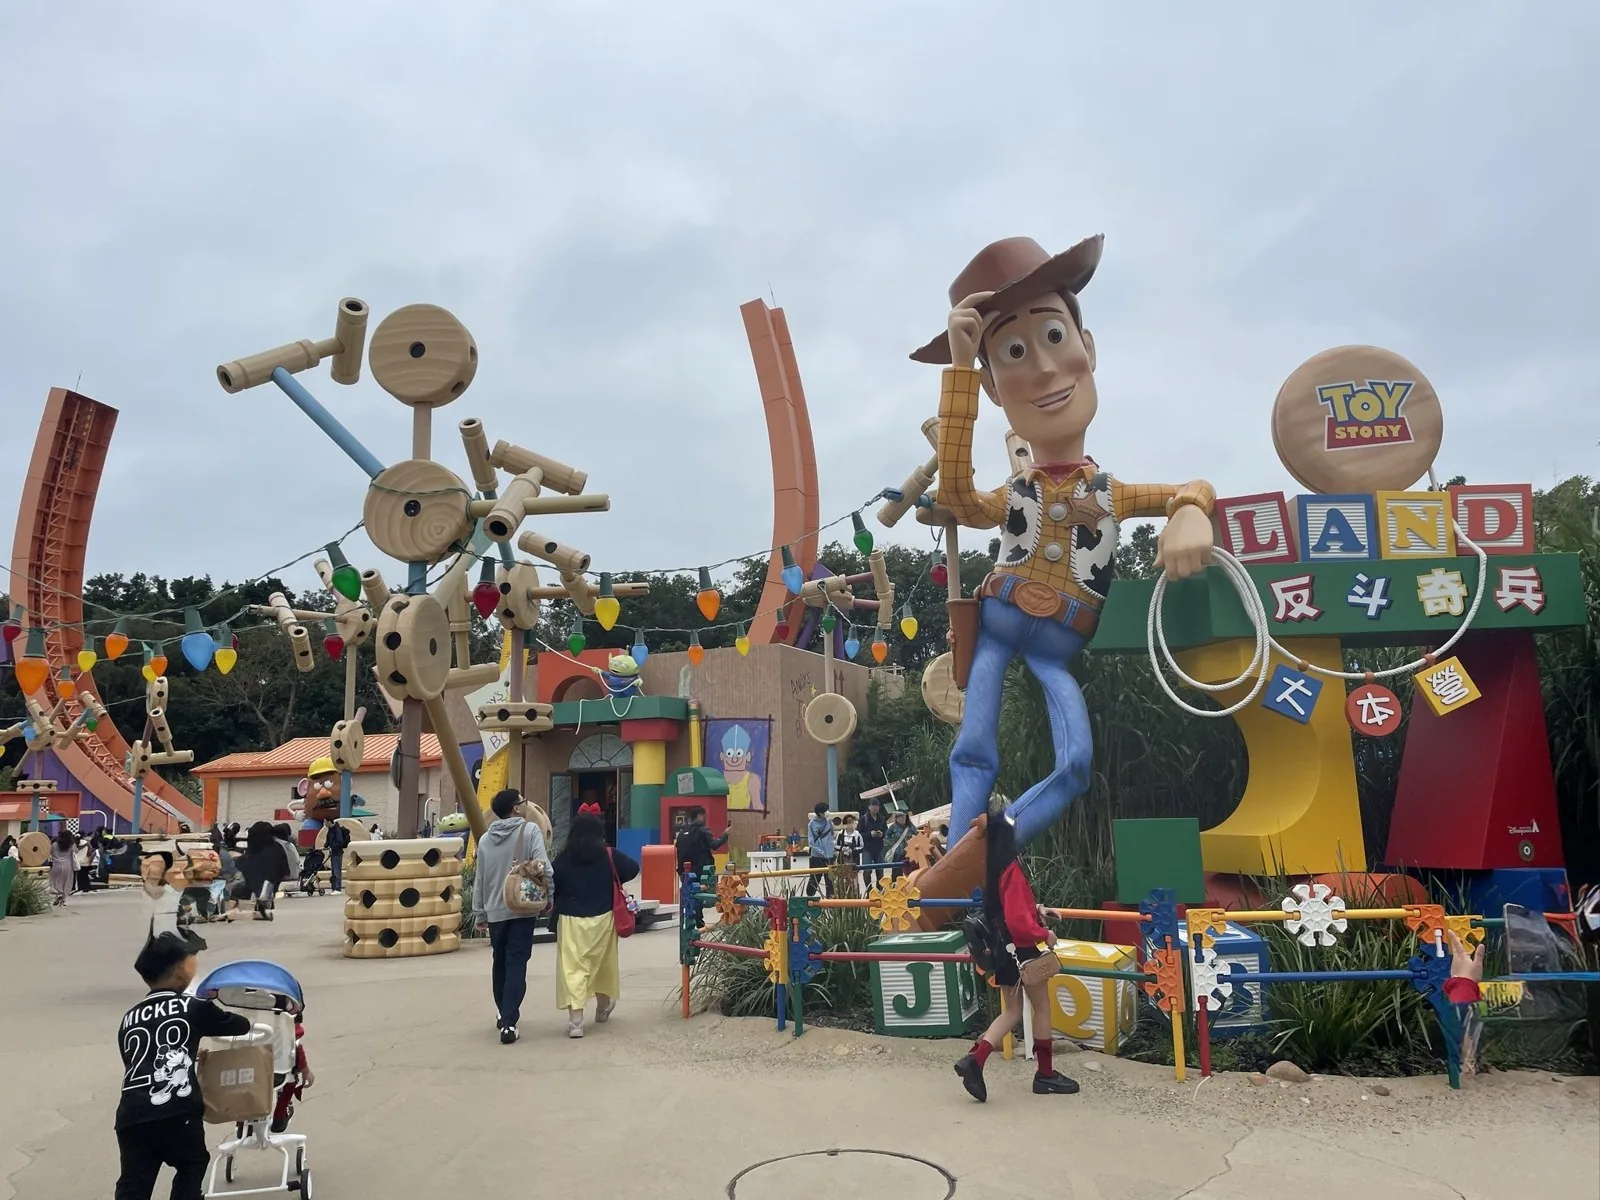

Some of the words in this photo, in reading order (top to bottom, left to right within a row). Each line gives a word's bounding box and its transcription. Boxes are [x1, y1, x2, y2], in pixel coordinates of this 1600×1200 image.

[1318, 381, 1412, 423] TOY
[1334, 425, 1402, 440] STORY
[1232, 498, 1519, 552] LAND
[1269, 567, 1545, 622] 反斗奇兵
[122, 997, 191, 1030] MICKEY
[892, 961, 935, 1018] J
[1048, 974, 1097, 1040] Q
